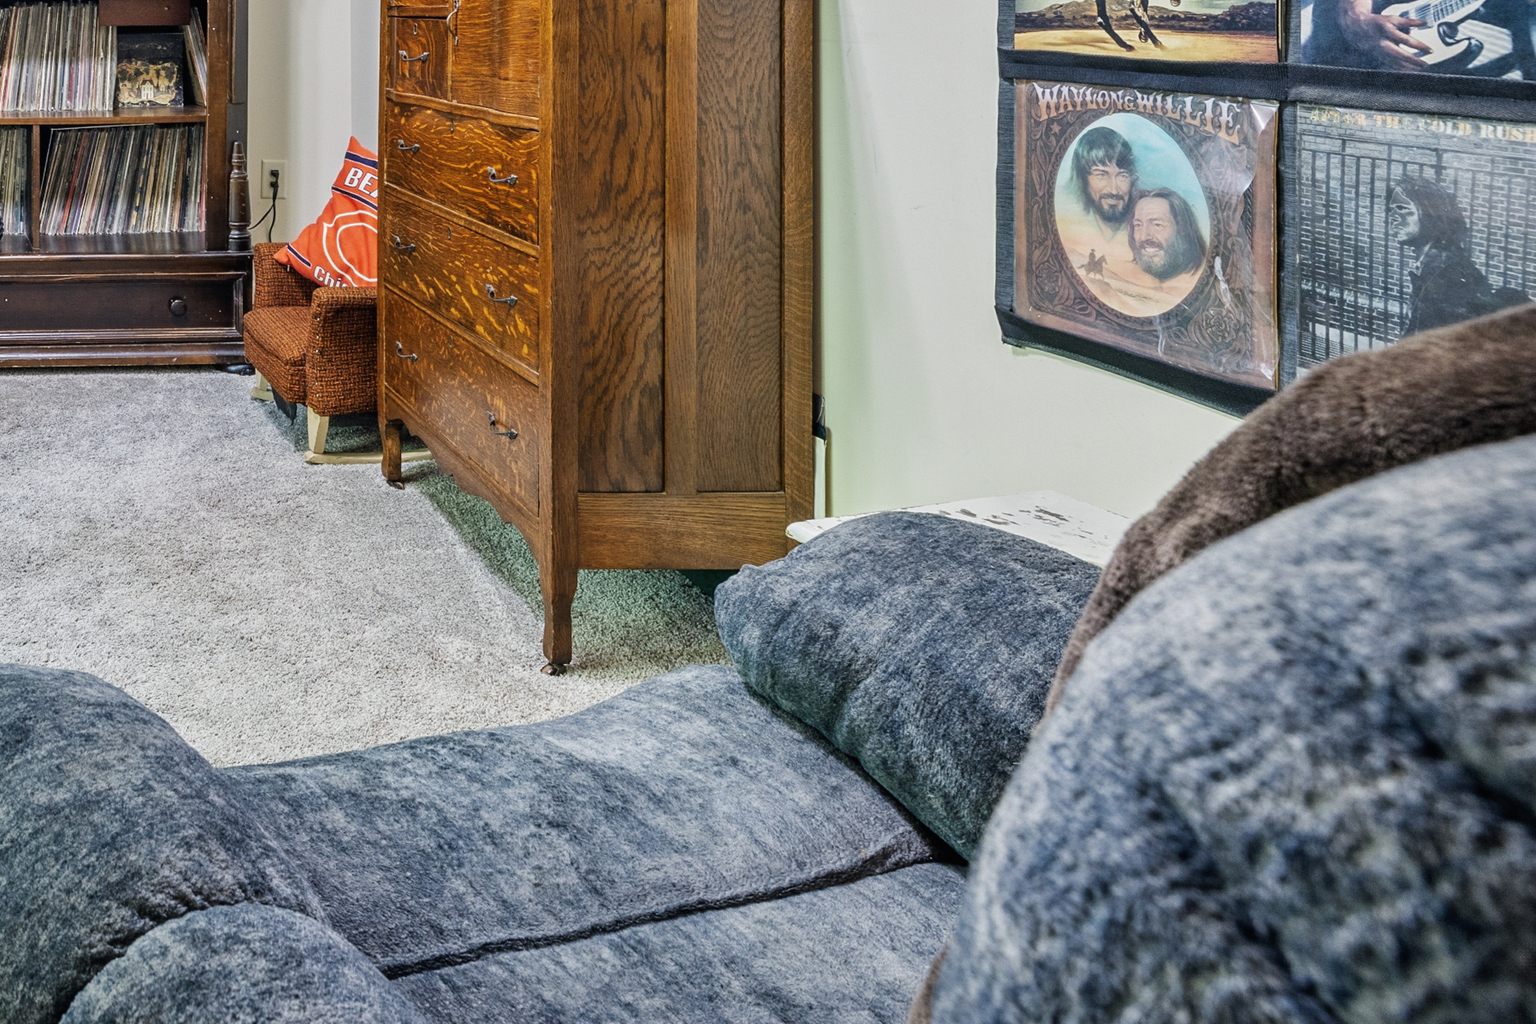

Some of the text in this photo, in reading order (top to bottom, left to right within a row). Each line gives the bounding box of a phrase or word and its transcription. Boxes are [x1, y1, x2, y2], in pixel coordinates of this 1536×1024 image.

[1033, 82, 1124, 121] WAYLON
[1135, 89, 1241, 145] WILLIE
[1479, 123, 1536, 143] RUSH
[313, 265, 350, 288] Chi
